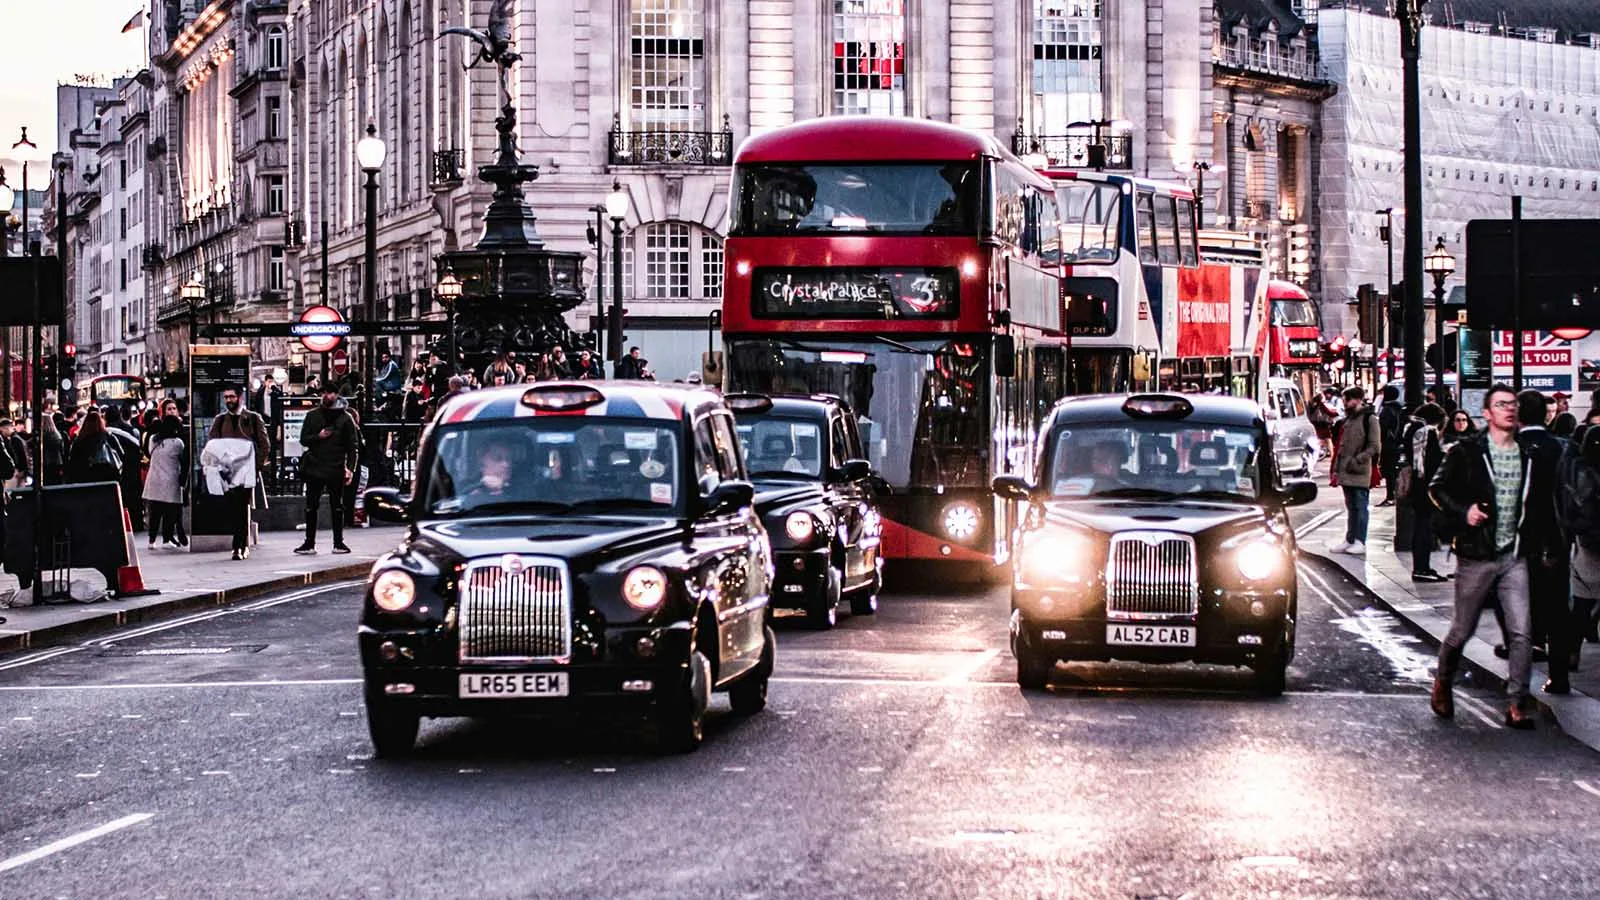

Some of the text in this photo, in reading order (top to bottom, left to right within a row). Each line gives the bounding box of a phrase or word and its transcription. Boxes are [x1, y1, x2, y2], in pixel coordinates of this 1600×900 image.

[770, 281, 823, 302] Crystal
[910, 277, 934, 307] 3
[1179, 301, 1190, 323] THE
[1191, 302, 1215, 323] ORIGINAL
[1216, 302, 1229, 323] TOUR
[291, 324, 350, 334] UNDERGROUND
[1505, 333, 1532, 344] TE
[1533, 352, 1569, 363] TOUR
[1528, 378, 1555, 387] HERE
[1113, 628, 1189, 643] AL52 CAB
[467, 675, 560, 693] LR65 EEM
